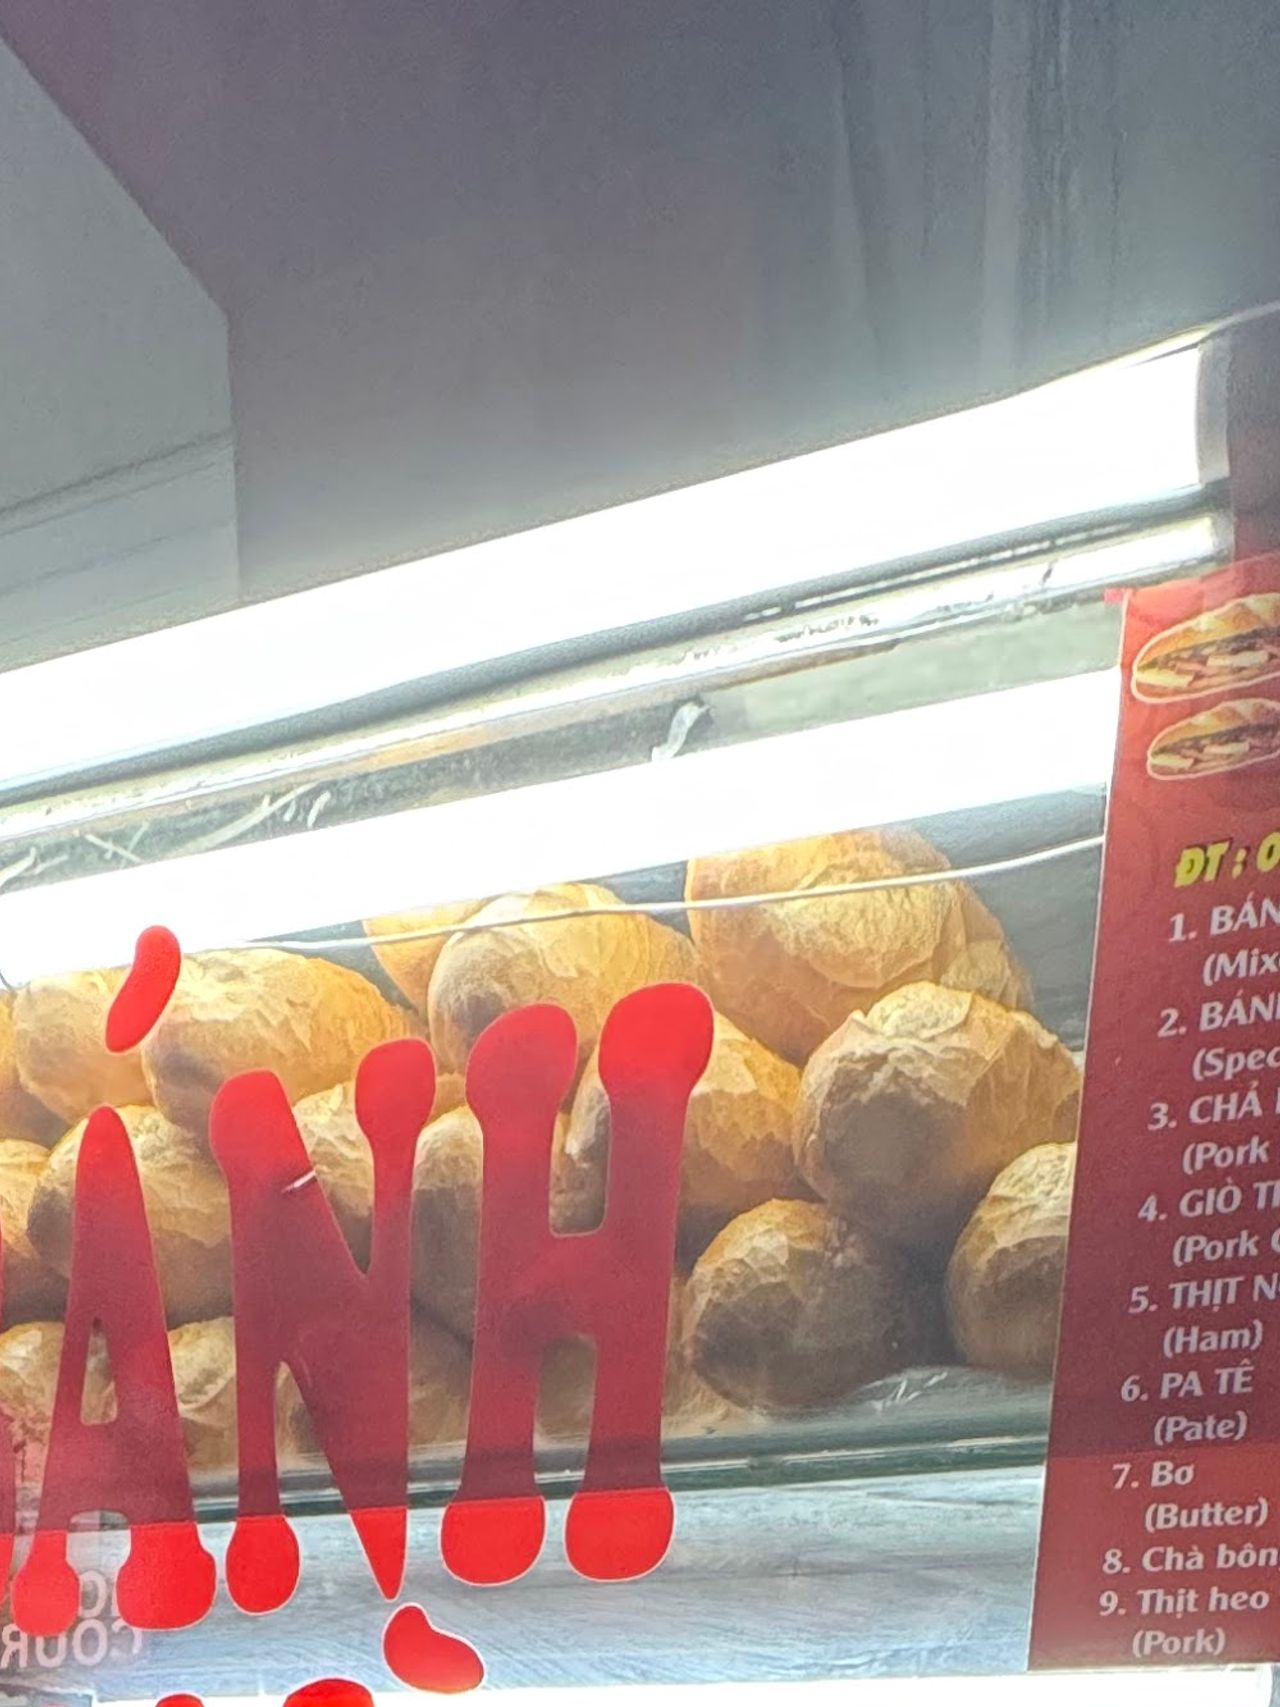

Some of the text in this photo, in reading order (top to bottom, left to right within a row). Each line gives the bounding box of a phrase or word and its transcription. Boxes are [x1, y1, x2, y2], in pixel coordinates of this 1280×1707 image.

[1169, 913, 1198, 944] 1.
[1158, 1007, 1187, 1038] 2.
[1148, 1102, 1177, 1132] 3.
[1189, 1080, 1263, 1126] CHẢ
[1182, 1138, 1270, 1175] (Pork
[1137, 1194, 1168, 1222] 4.
[1179, 1177, 1243, 1218] GIÒ
[1172, 1230, 1260, 1268] (Pork
[1128, 1286, 1158, 1314] 5.
[1169, 1275, 1245, 1313] THỊT
[1162, 1319, 1264, 1358] (Ham)
[1120, 1358, 1255, 1402] 6. PA TÊ
[1153, 1410, 1248, 1447] (Pate)
[1112, 1460, 1195, 1489] 7. Bơ
[1144, 1497, 1270, 1534] (Butter)
[1102, 1548, 1131, 1575] 8.
[1141, 1544, 1205, 1573] Chà
[1099, 1585, 1270, 1619] 9. Thịt heo
[1132, 1627, 1227, 1658] (Pork)
